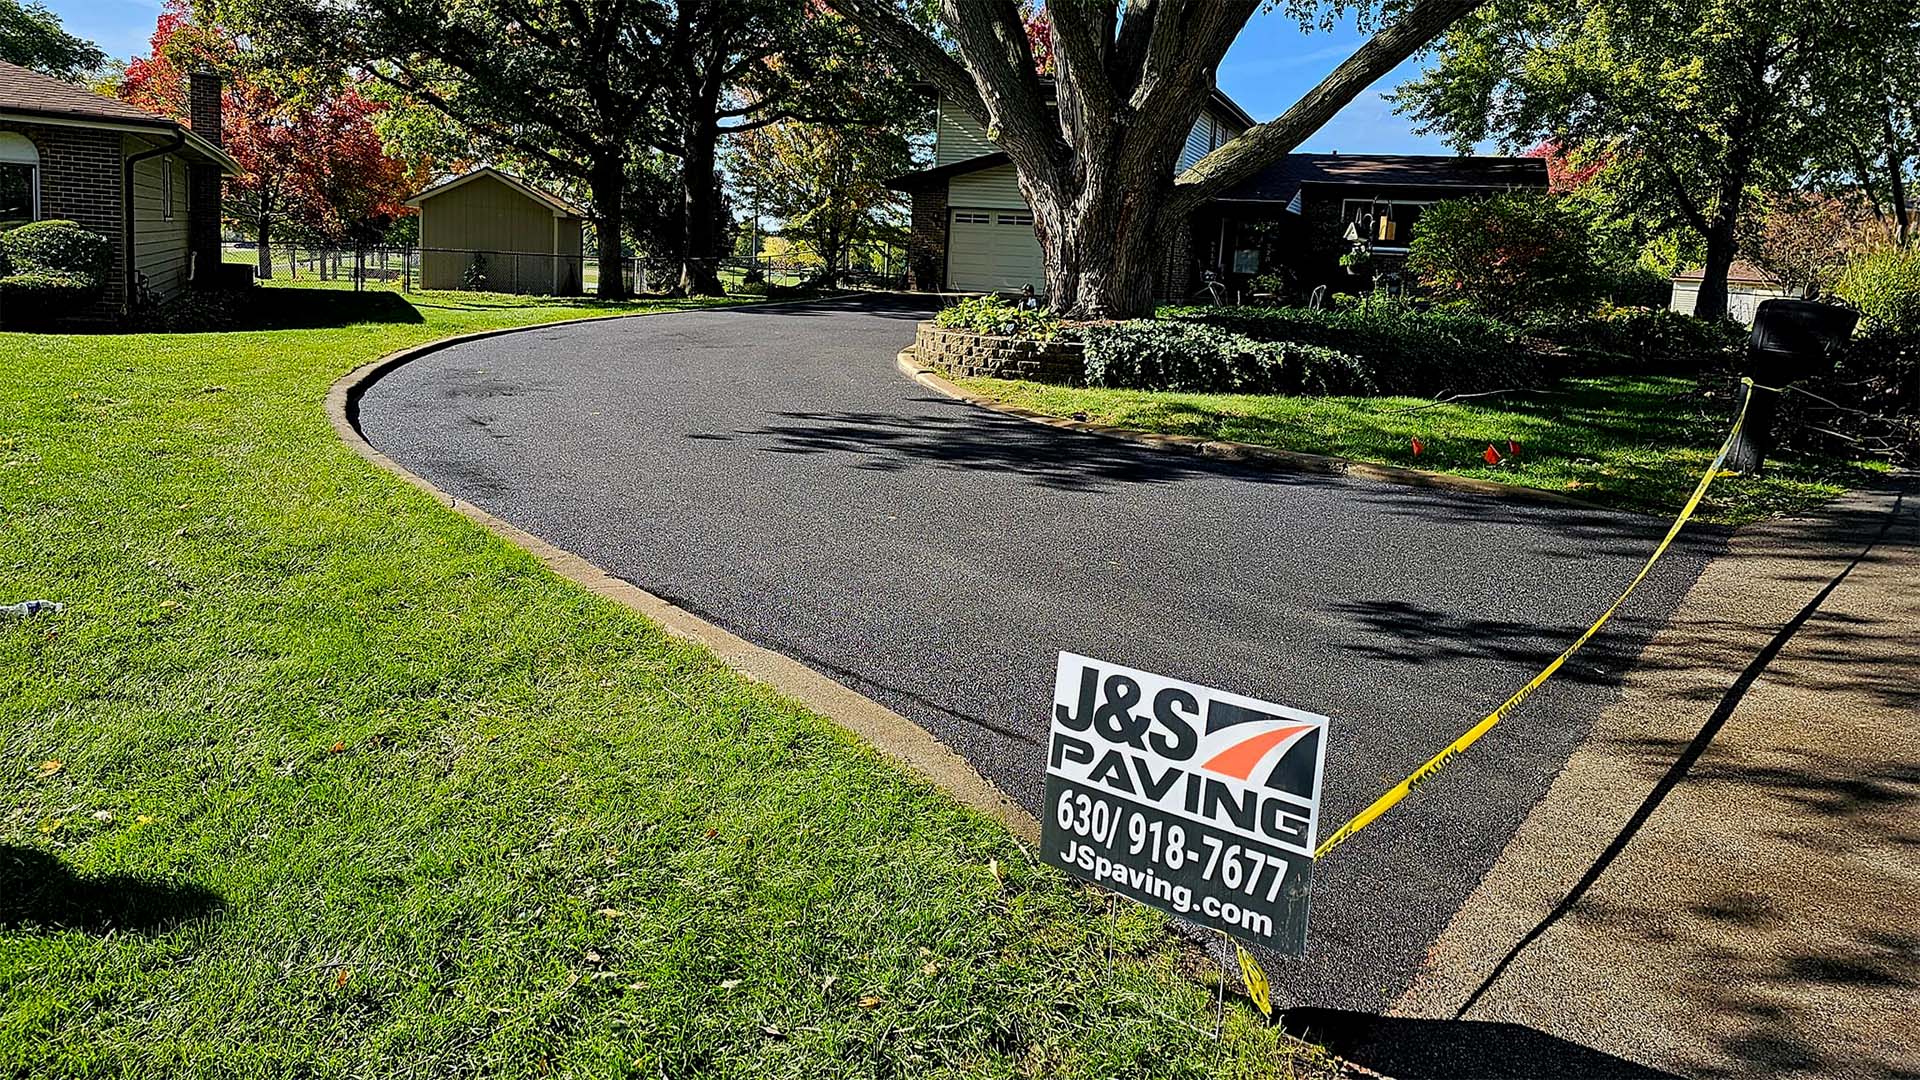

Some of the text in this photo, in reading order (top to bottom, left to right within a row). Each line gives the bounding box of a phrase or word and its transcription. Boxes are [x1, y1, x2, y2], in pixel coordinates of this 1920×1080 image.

[1055, 666, 1200, 761] J&S
[1050, 732, 1311, 849] PAVING
[1056, 789, 1123, 849] 630/
[1128, 812, 1288, 904] 918-7677
[1059, 840, 1273, 938] JSpaving.com
